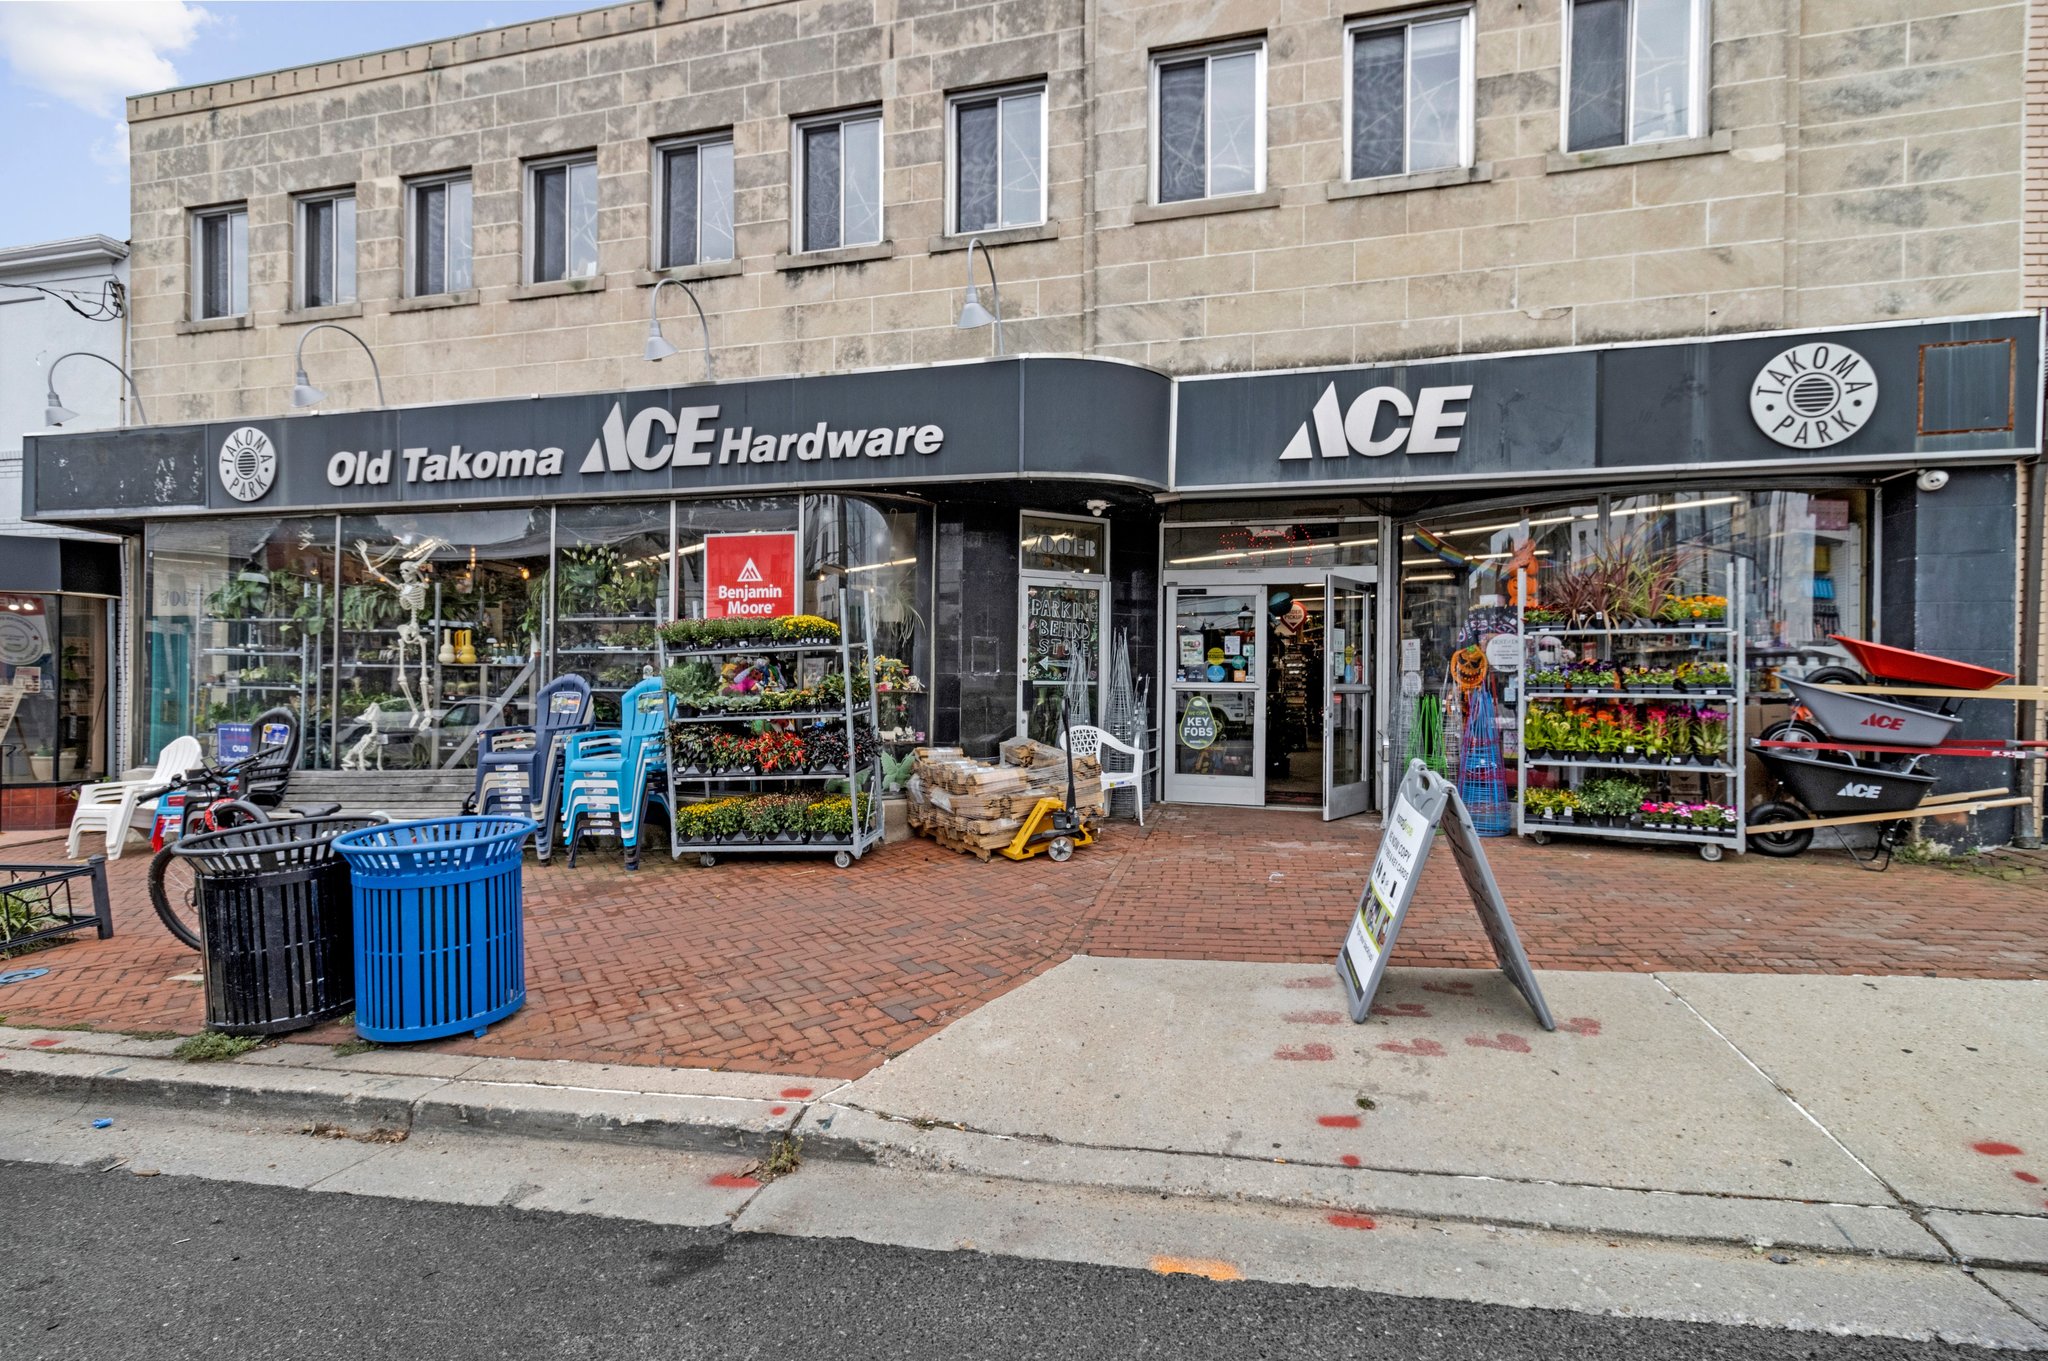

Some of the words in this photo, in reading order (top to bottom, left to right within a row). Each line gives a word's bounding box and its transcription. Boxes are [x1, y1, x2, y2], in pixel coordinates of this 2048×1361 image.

[1756, 346, 1873, 396] TAKOMA
[1279, 380, 1474, 460] ACE
[1772, 410, 1857, 444] PARK
[221, 429, 273, 464] TAKOMA
[327, 449, 392, 487] Old
[402, 445, 565, 483] Takoma
[579, 401, 721, 473] ACE
[718, 422, 944, 464] Hardware
[229, 475, 267, 498] PARK
[718, 584, 782, 602] Benjamin
[727, 601, 772, 614] Moore
[1031, 599, 1098, 621] PARKING
[1039, 619, 1091, 639] BEHIND
[1038, 639, 1090, 656] STORE
[1187, 717, 1209, 726] KEY
[1860, 712, 1906, 731] ACE
[1184, 727, 1213, 737] FOBS
[232, 745, 249, 753] OUR
[1837, 782, 1882, 799] ACE
[1398, 843, 1411, 862] COPY
